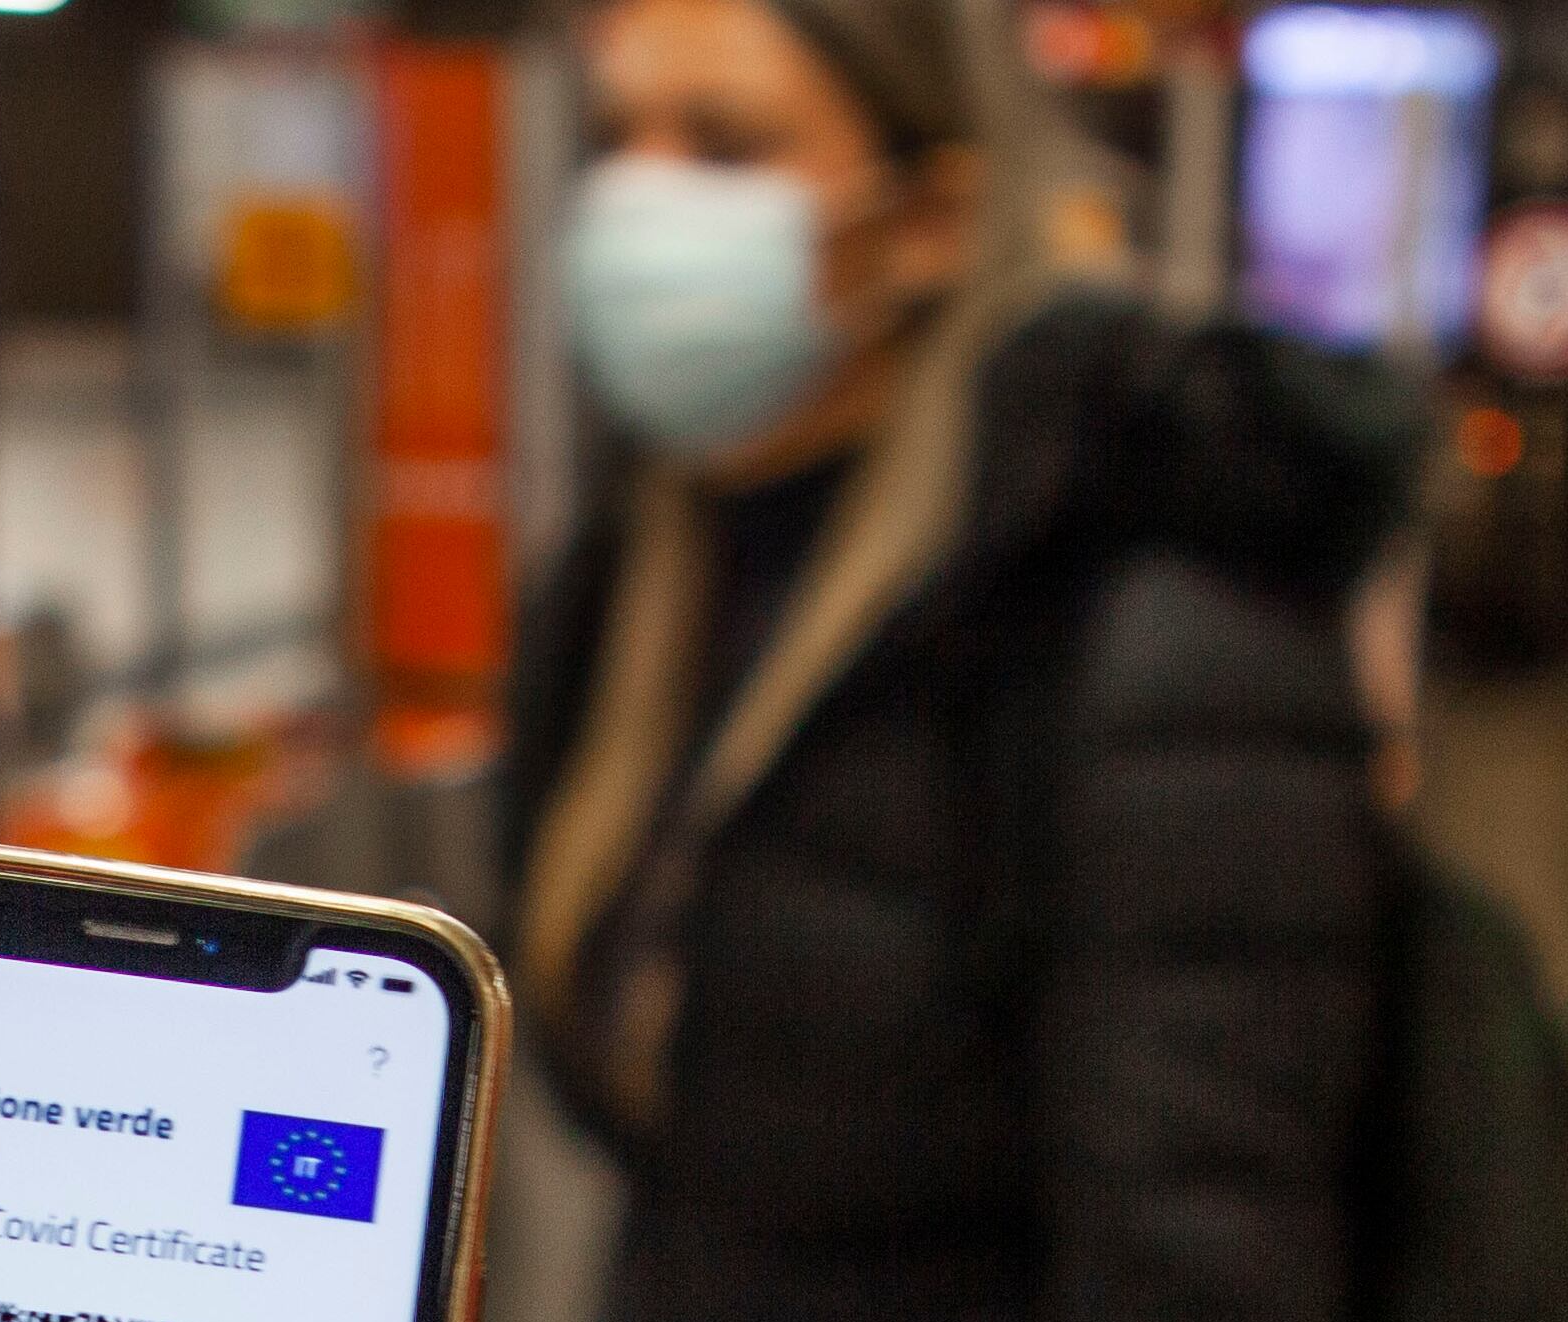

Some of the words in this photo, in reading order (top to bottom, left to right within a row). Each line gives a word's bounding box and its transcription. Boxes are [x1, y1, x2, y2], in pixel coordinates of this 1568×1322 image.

[367, 1045, 391, 1079] ?
[75, 1106, 176, 1141] verde
[293, 1155, 322, 1179] IT
[88, 1216, 269, 1275] Certificate
